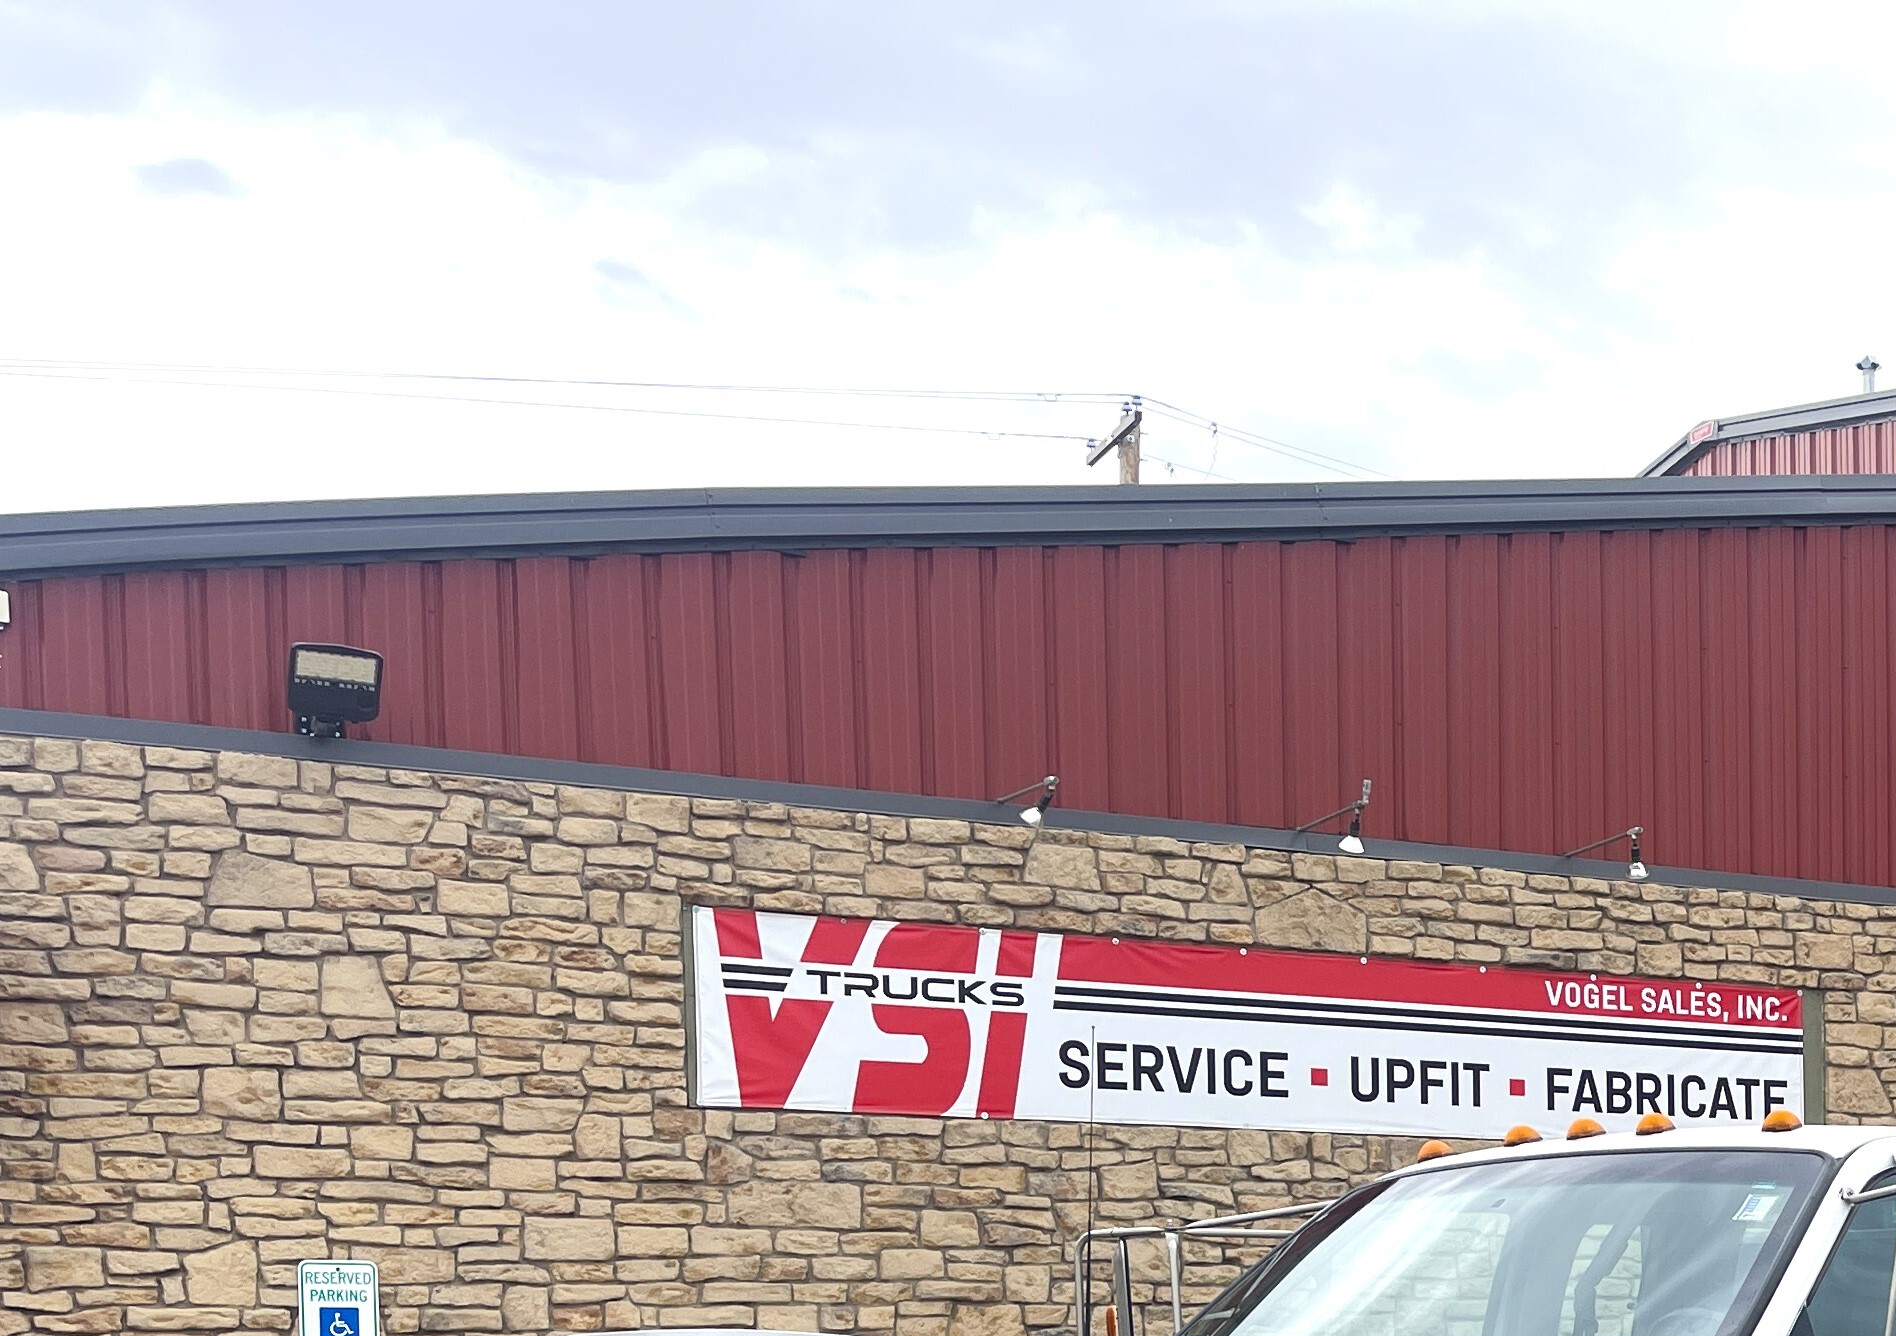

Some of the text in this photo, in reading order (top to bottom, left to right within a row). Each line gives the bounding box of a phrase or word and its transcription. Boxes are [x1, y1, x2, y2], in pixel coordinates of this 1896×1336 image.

[805, 969, 1025, 1007] TRUCKS
[1545, 980, 1788, 1024] VOGEL SALES, INC.
[713, 908, 1039, 1119] VSI
[1058, 1039, 1788, 1121] SERVICE UPFIT FABRICATE
[305, 1271, 371, 1285] RESERVED
[310, 1289, 368, 1302] PARKING
